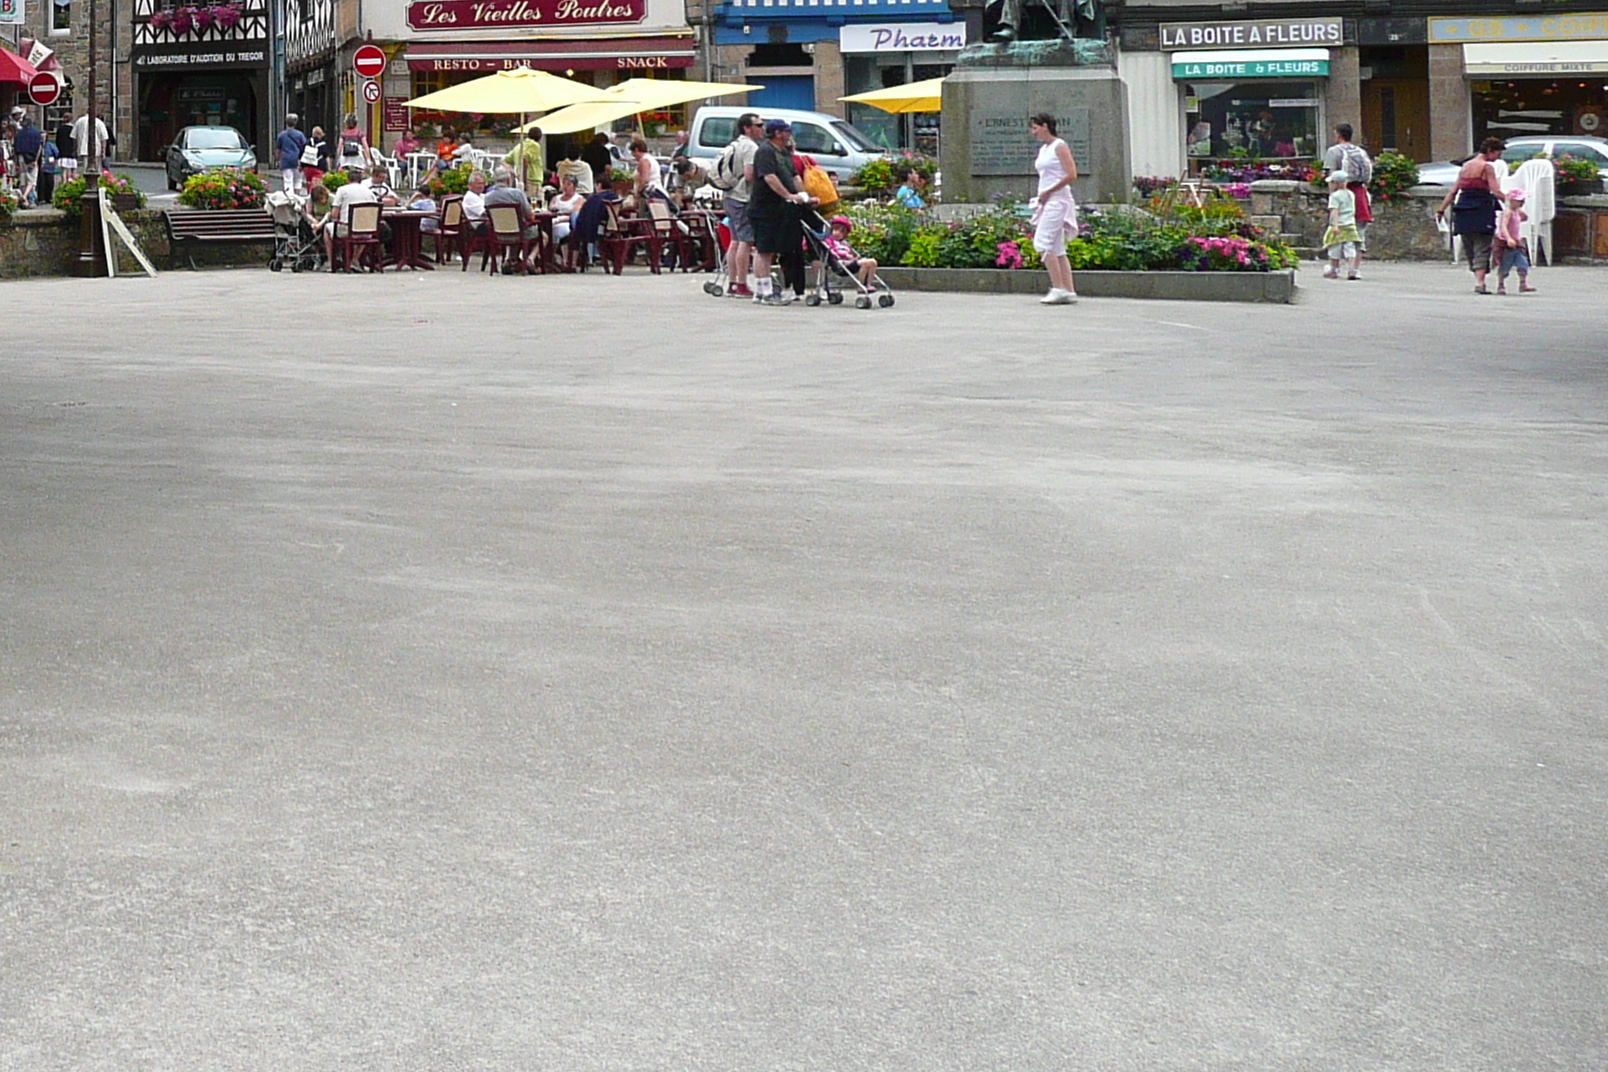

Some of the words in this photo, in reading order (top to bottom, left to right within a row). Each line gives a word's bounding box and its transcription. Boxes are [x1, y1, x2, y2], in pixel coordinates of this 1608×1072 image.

[420, 3, 457, 24] Les
[470, 0, 542, 22] Vieilles
[1162, 28, 1187, 46] LA
[1191, 26, 1245, 44] BOITE
[1249, 25, 1262, 42] A
[1266, 23, 1340, 41] FLEURS
[226, 52, 236, 62] DU
[434, 59, 480, 71] RESTO
[503, 58, 532, 70] BAR
[617, 56, 668, 69] SNACK
[1185, 64, 1201, 75] LA
[1206, 63, 1246, 74] BOITE
[1267, 61, 1320, 73] FLEURS
